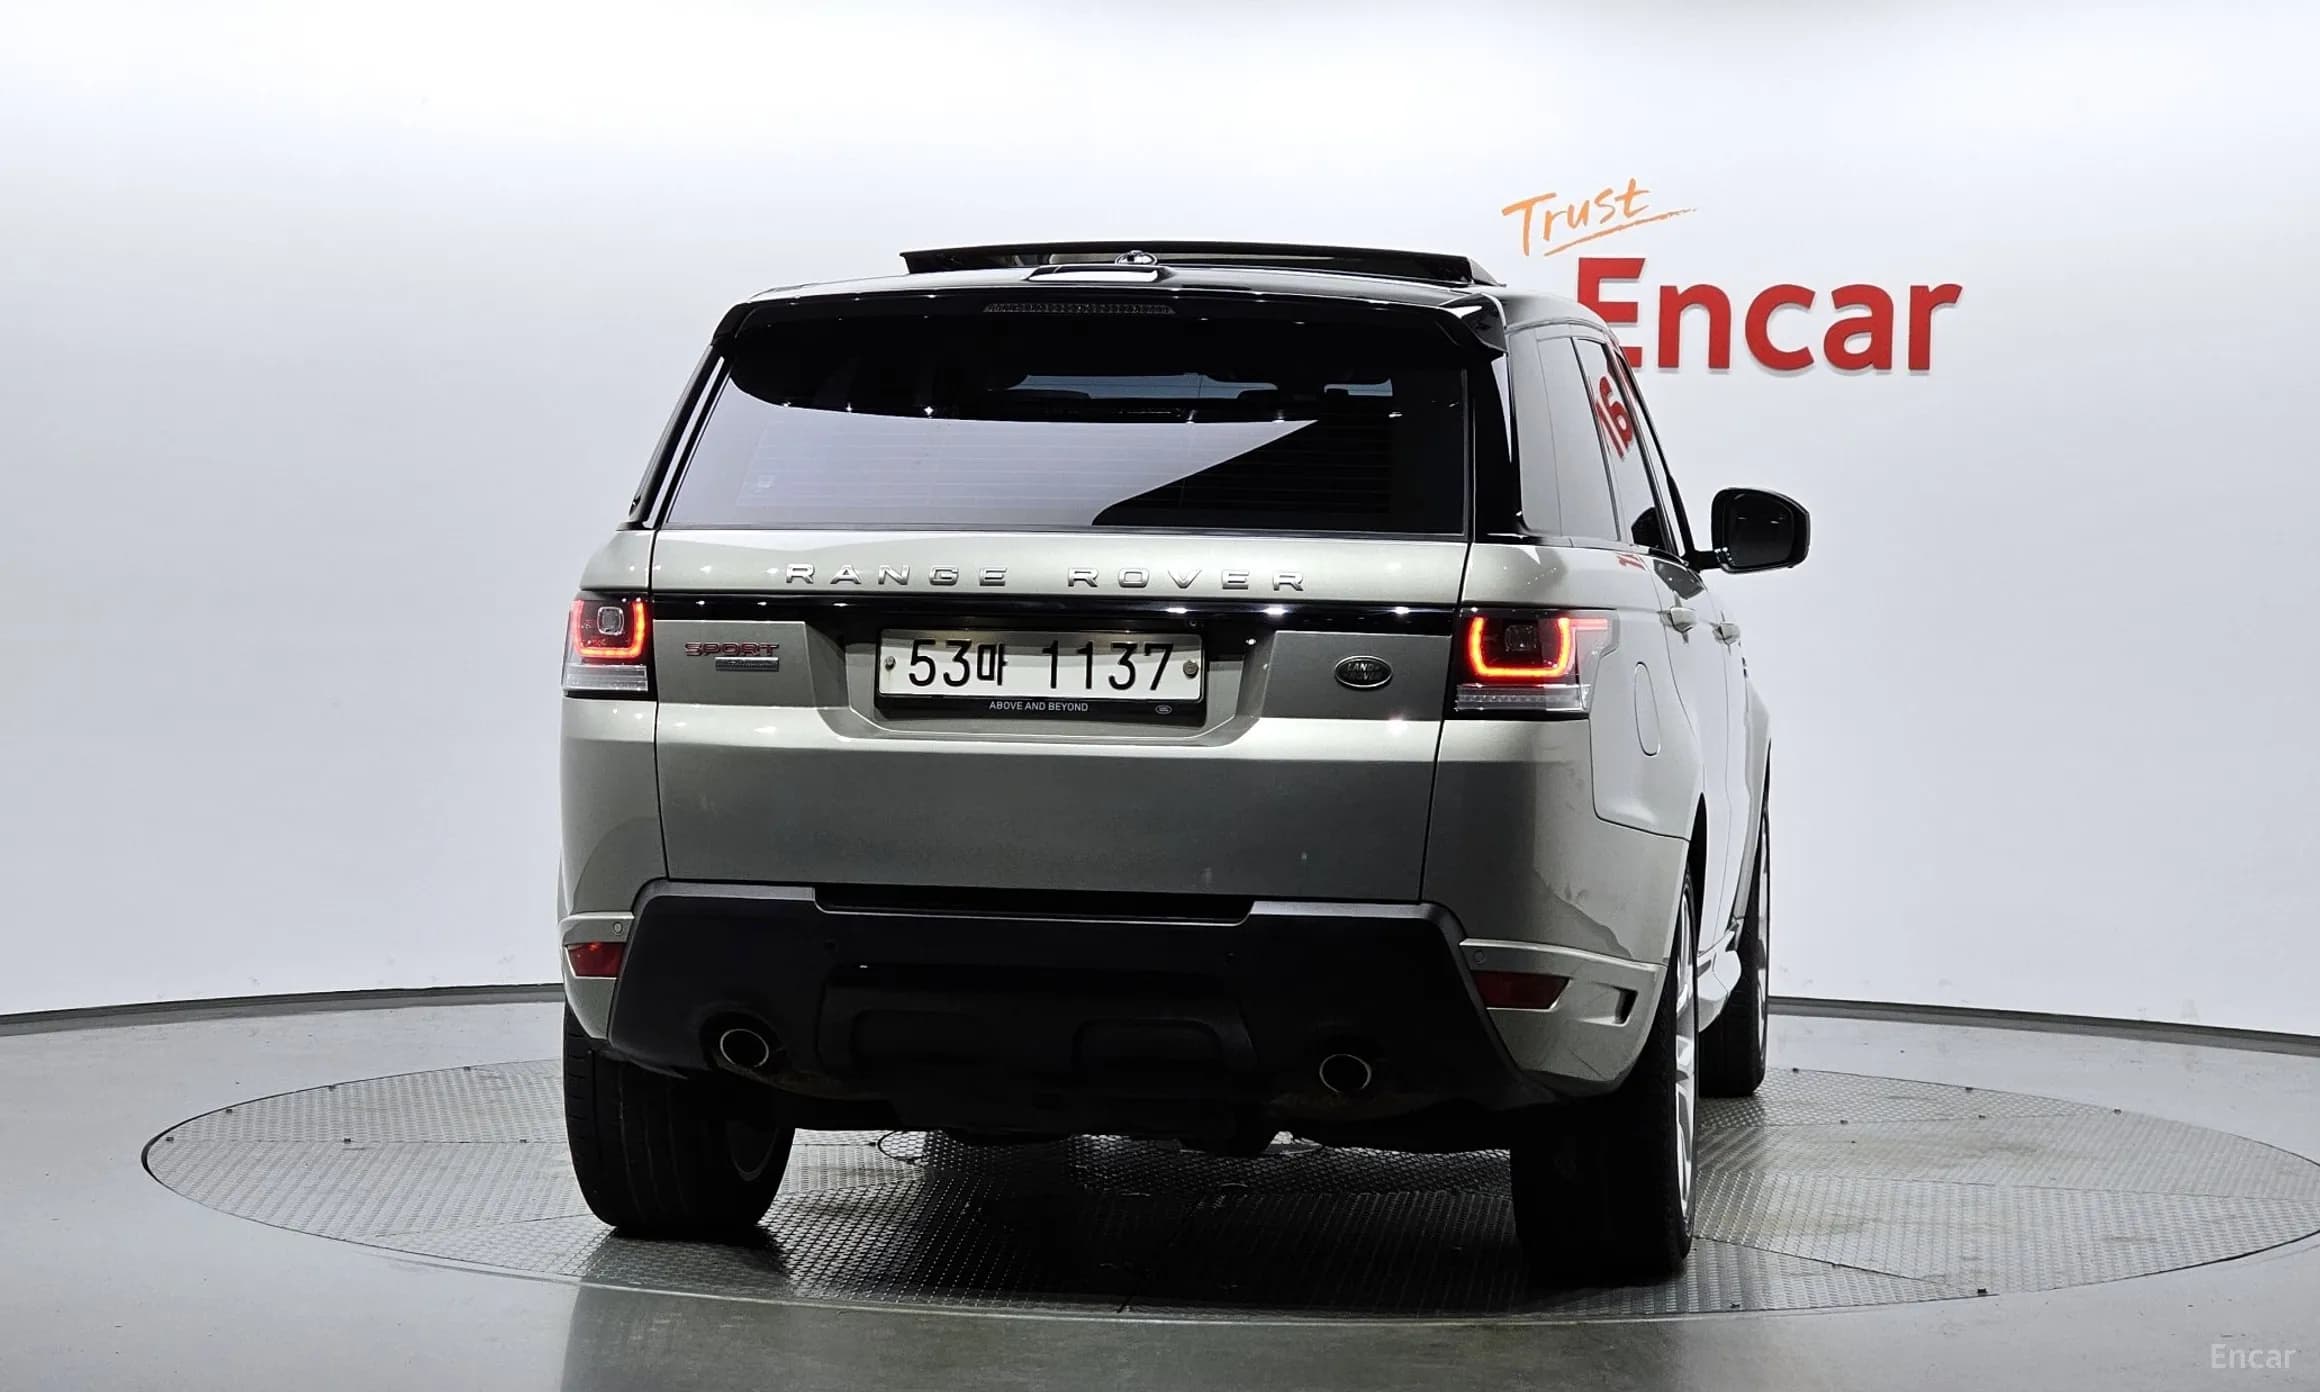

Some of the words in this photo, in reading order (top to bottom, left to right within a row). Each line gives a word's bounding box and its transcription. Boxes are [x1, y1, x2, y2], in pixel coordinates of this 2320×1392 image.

[1501, 177, 1649, 257] Trust
[1577, 257, 1963, 371] Encar
[785, 563, 1007, 587] RANGE
[1067, 567, 1303, 592] ROVER
[684, 642, 779, 657] SPORT
[908, 638, 1009, 688] 53마
[1042, 639, 1174, 691] 1137
[988, 701, 1023, 711] ABOVE
[1024, 702, 1046, 711] AND
[1048, 702, 1089, 712] BEYOND
